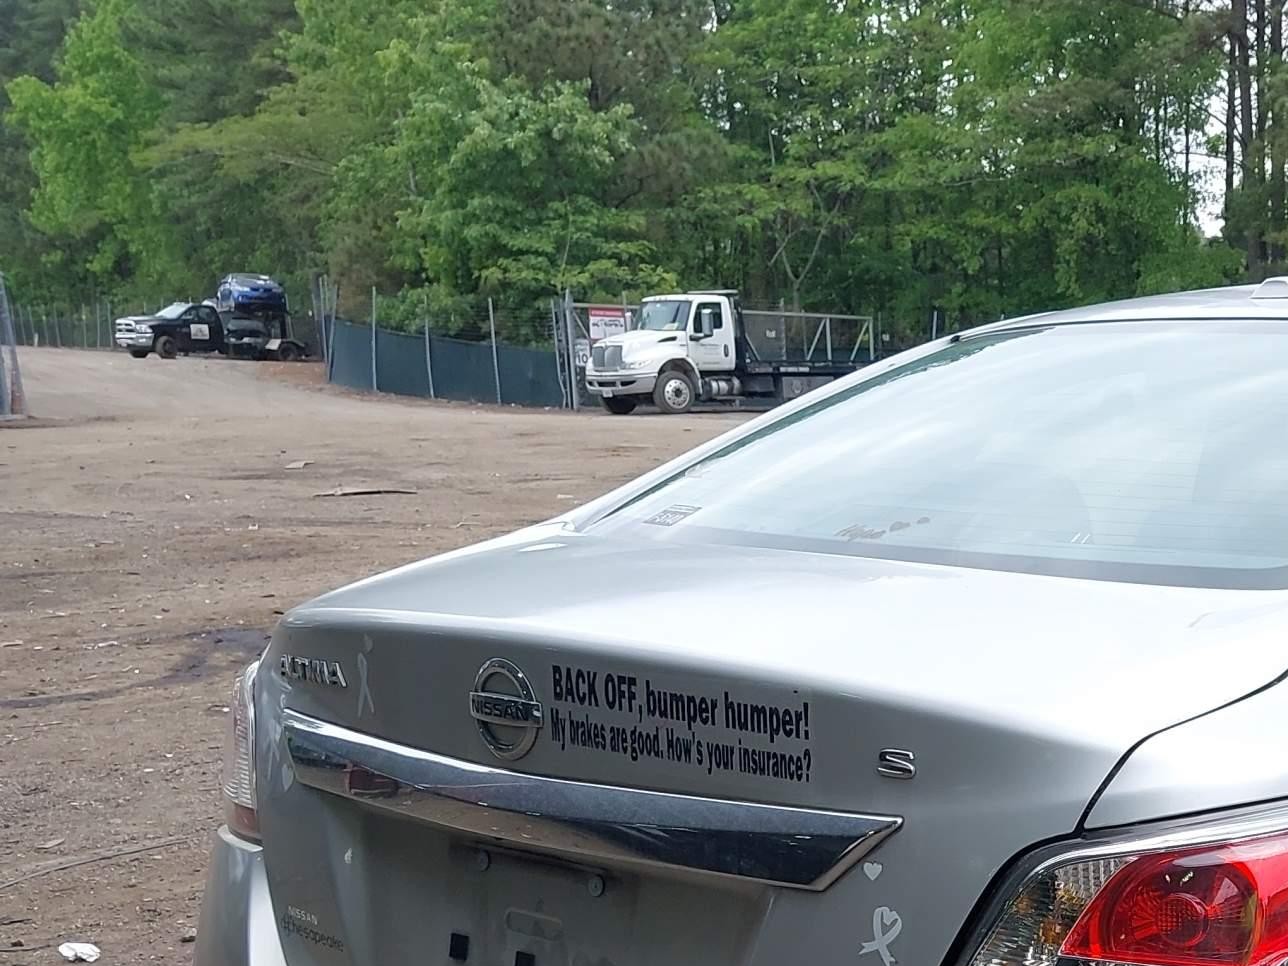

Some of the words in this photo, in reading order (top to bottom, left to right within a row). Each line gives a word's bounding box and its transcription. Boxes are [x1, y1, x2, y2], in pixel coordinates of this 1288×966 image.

[472, 696, 528, 721] NISSAN
[552, 664, 599, 707] BACK
[604, 673, 644, 723] OFF,
[645, 679, 718, 731] bumper
[724, 691, 809, 743] humper!
[550, 707, 566, 751] My
[568, 711, 606, 751] brakes
[609, 726, 628, 755] are
[629, 725, 664, 762] good.
[666, 727, 704, 766] How's
[706, 741, 735, 775] your
[738, 738, 812, 783] insurance?
[877, 748, 916, 780] S
[288, 905, 318, 926] NISSAN
